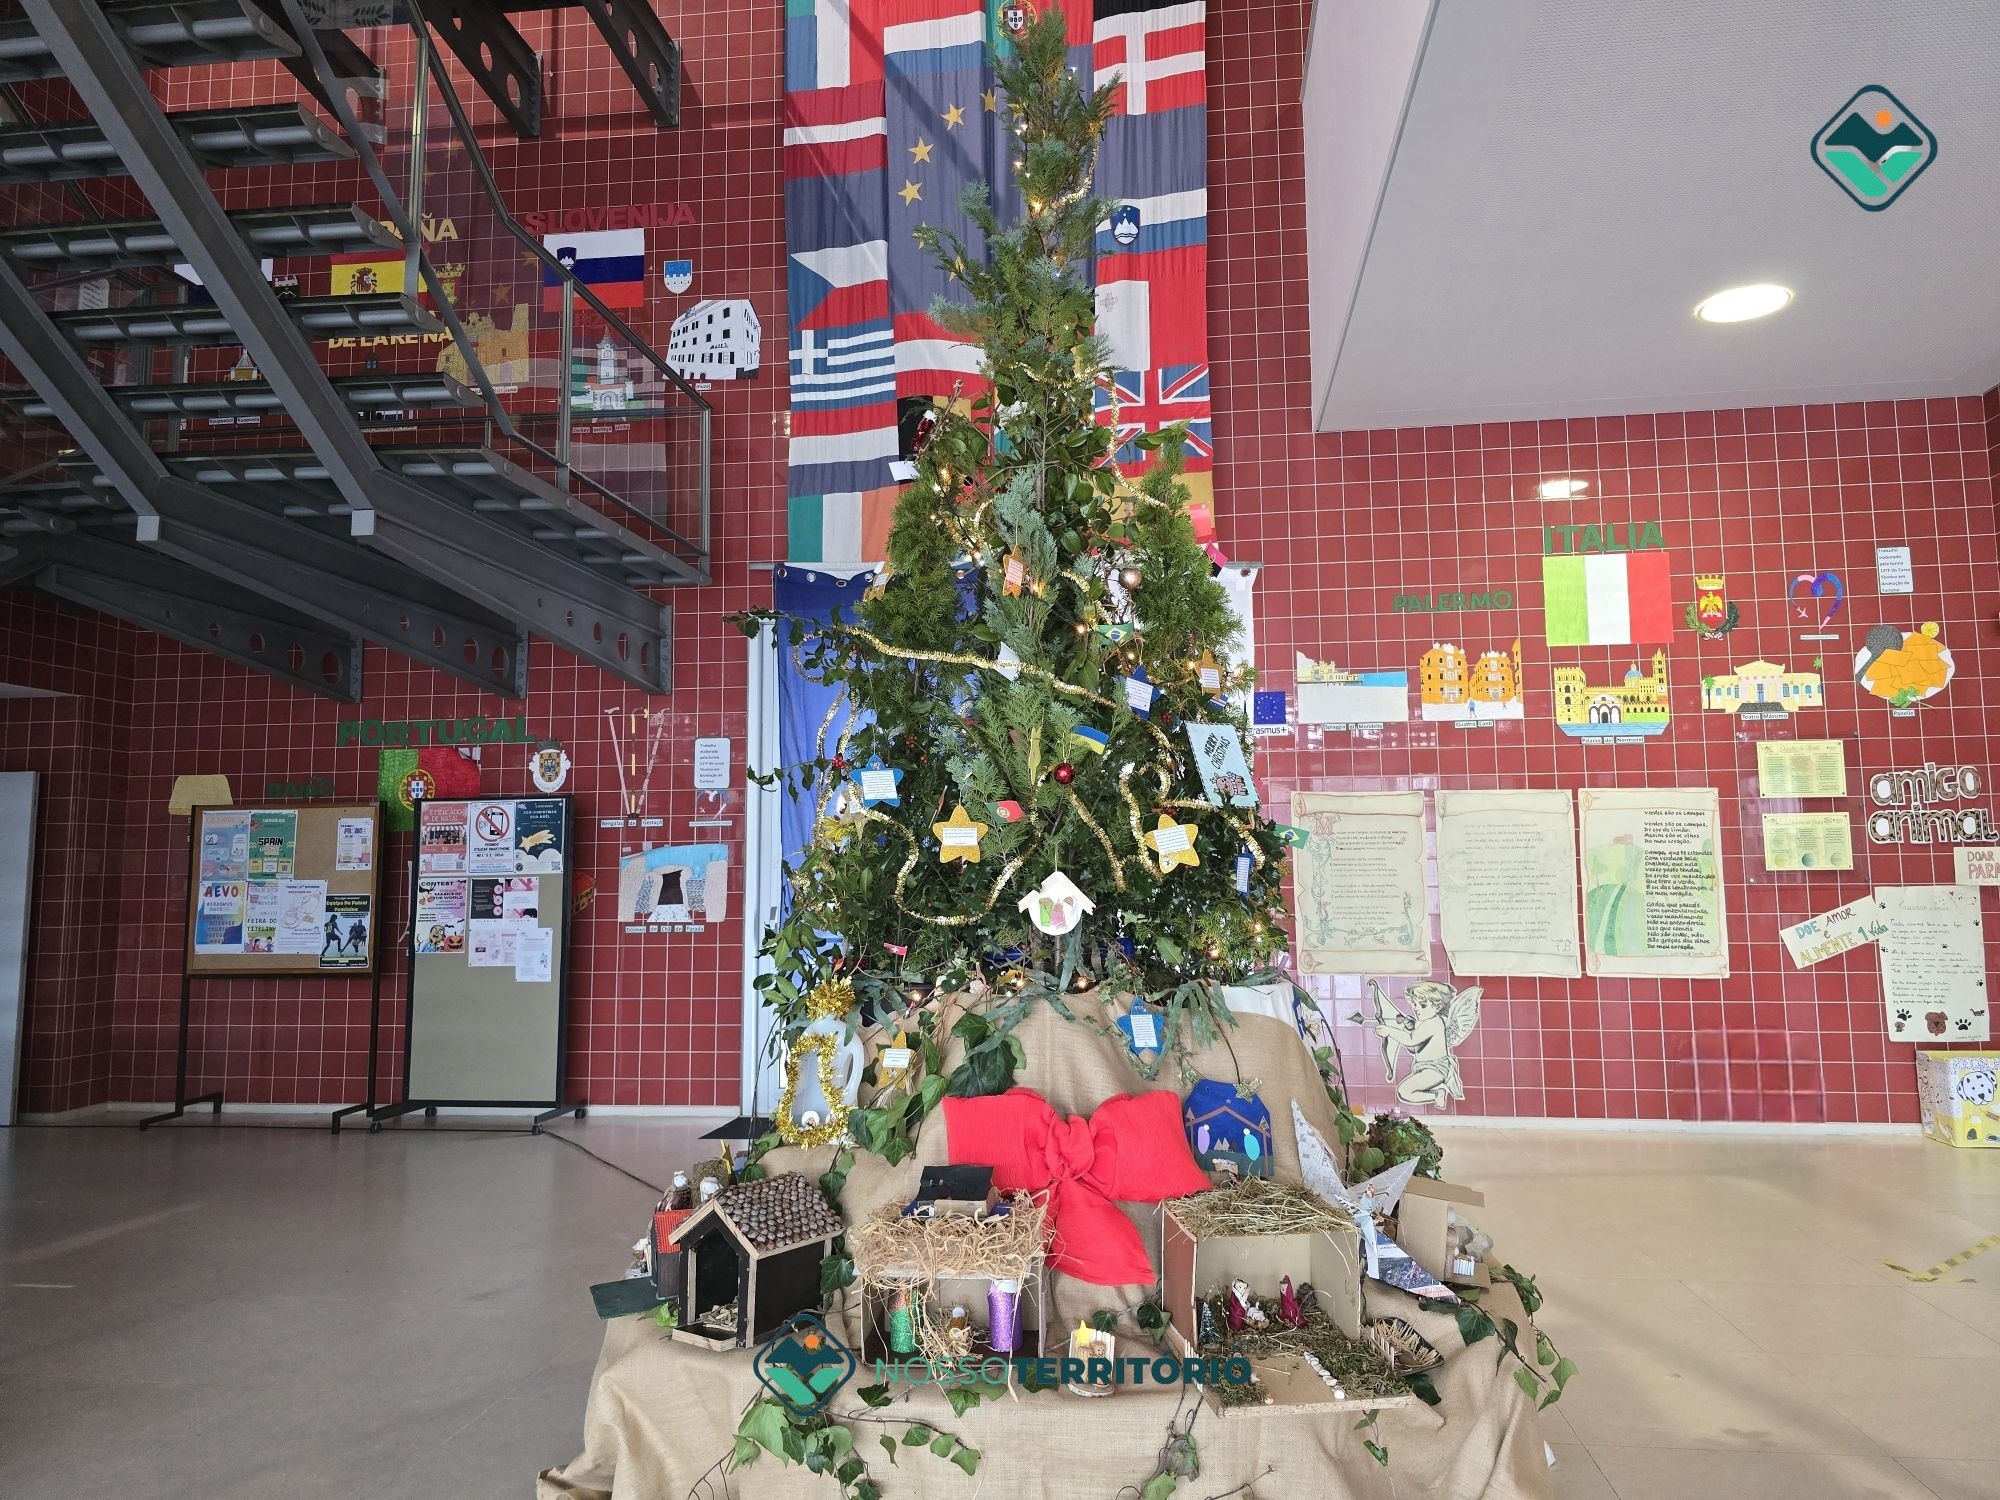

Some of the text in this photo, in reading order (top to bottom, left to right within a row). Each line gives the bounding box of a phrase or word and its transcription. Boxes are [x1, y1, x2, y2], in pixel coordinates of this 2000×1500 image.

[525, 203, 697, 234] SLOVENIJA
[1543, 520, 1666, 554] ITALIA
[1392, 590, 1513, 613] PALERMO
[337, 715, 536, 748] PORTUGAL
[1252, 726, 1287, 735] rasmus+
[1203, 732, 1219, 758] MERRY
[1210, 735, 1231, 770] CHRISTMAS
[1868, 802, 1999, 843] animal
[258, 837, 284, 846] SPAIN
[1967, 850, 1994, 861] DOAR
[204, 885, 239, 898] AEVO
[1795, 907, 1856, 939] DOE AMOR
[1823, 930, 1831, 939] e
[1799, 931, 1858, 966] ALIMENTE
